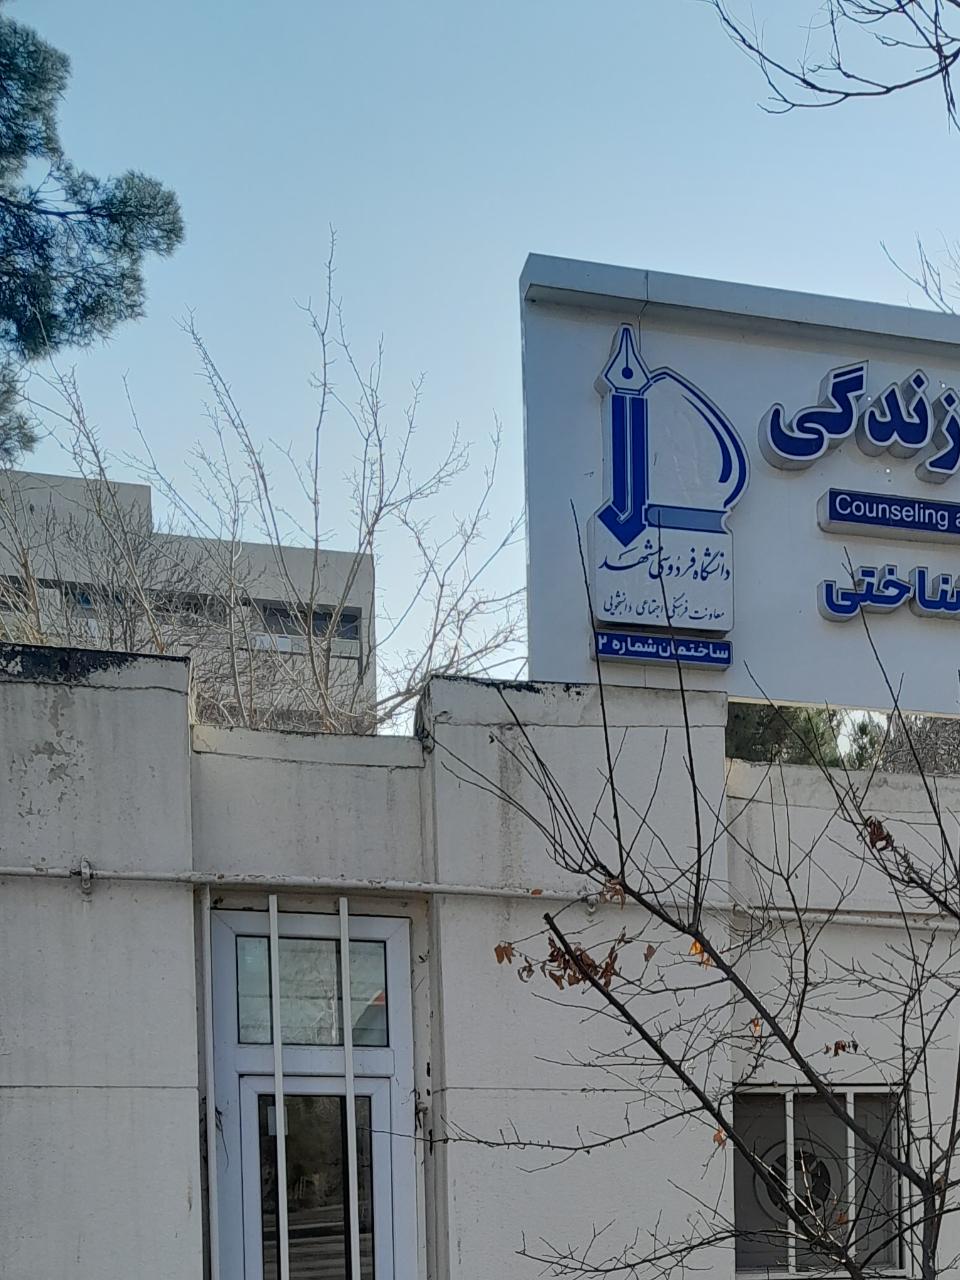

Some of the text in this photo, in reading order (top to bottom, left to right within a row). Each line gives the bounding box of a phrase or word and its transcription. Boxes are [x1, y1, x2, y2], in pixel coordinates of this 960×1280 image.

[834, 494, 949, 530] Counseling
[692, 548, 731, 581] دانشگاه
[611, 636, 657, 655] شماره
[658, 639, 729, 659] ساختمان
